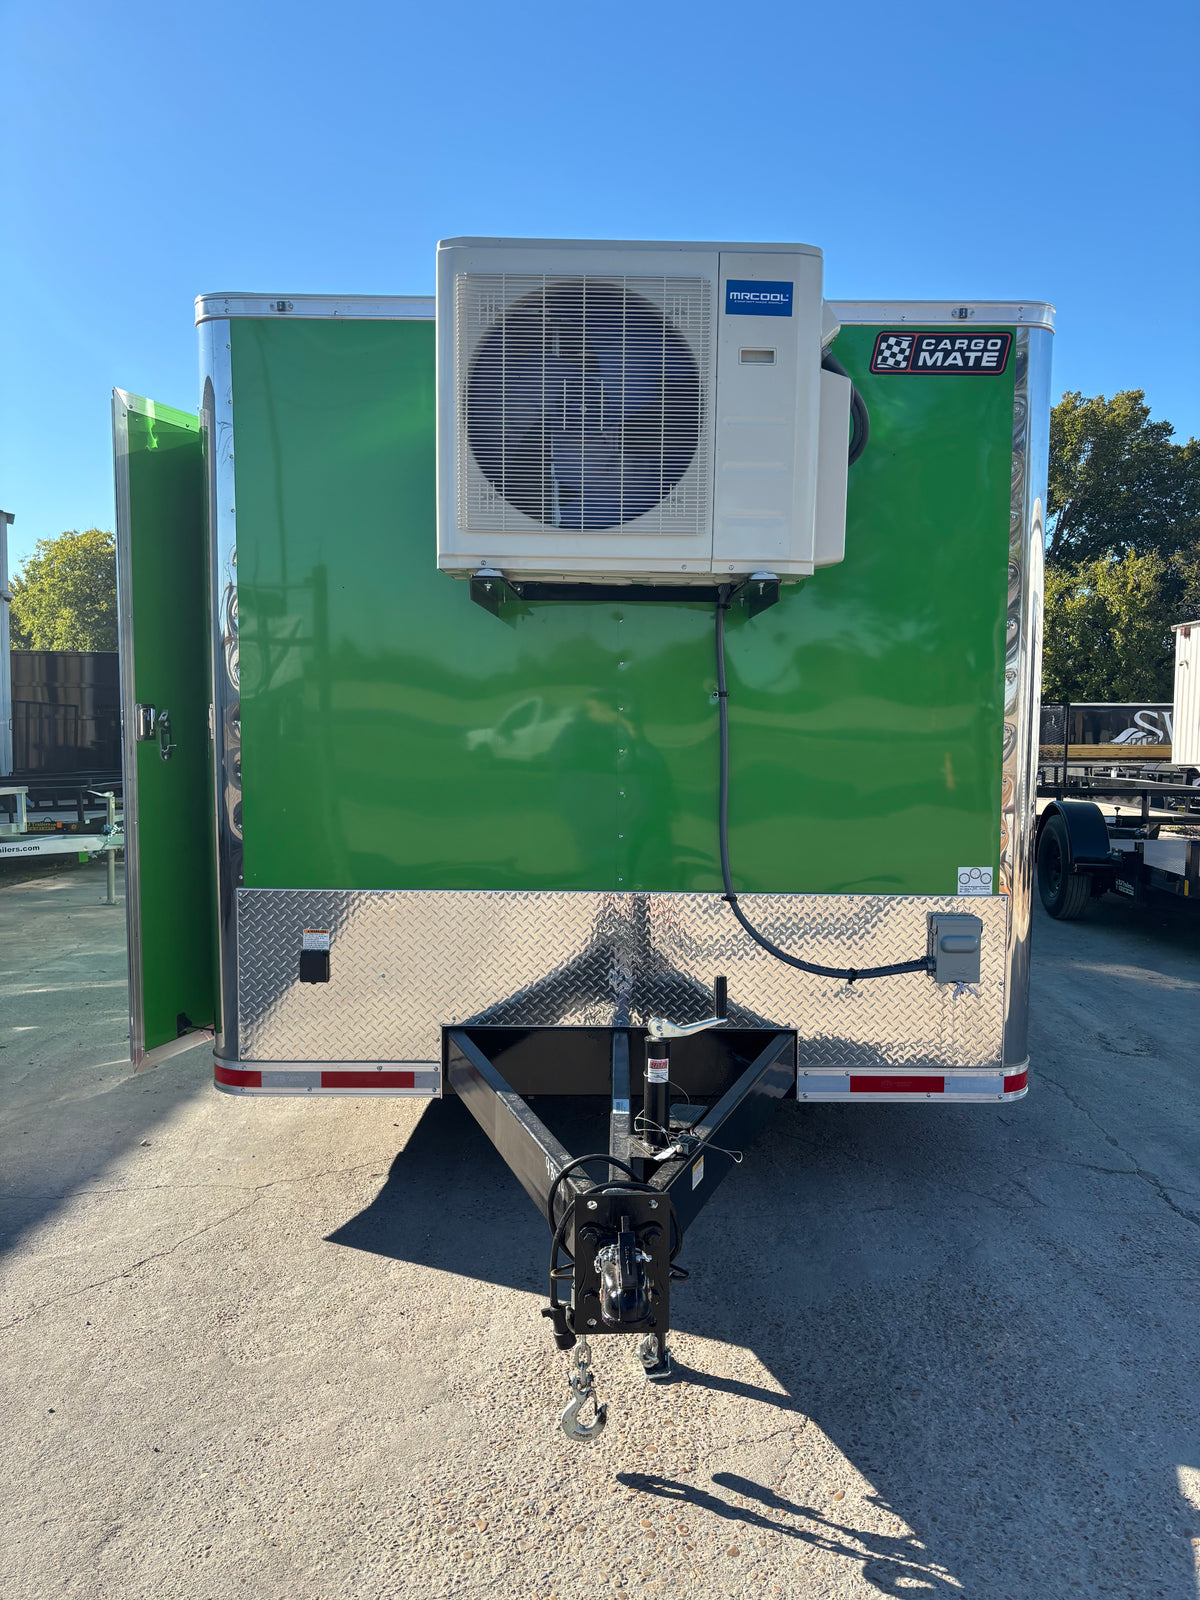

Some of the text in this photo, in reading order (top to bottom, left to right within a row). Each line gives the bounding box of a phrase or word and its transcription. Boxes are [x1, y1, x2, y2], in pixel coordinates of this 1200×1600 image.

[730, 292, 789, 301] MRCOOL
[922, 339, 1002, 350] CARGO
[918, 352, 999, 367] MATE
